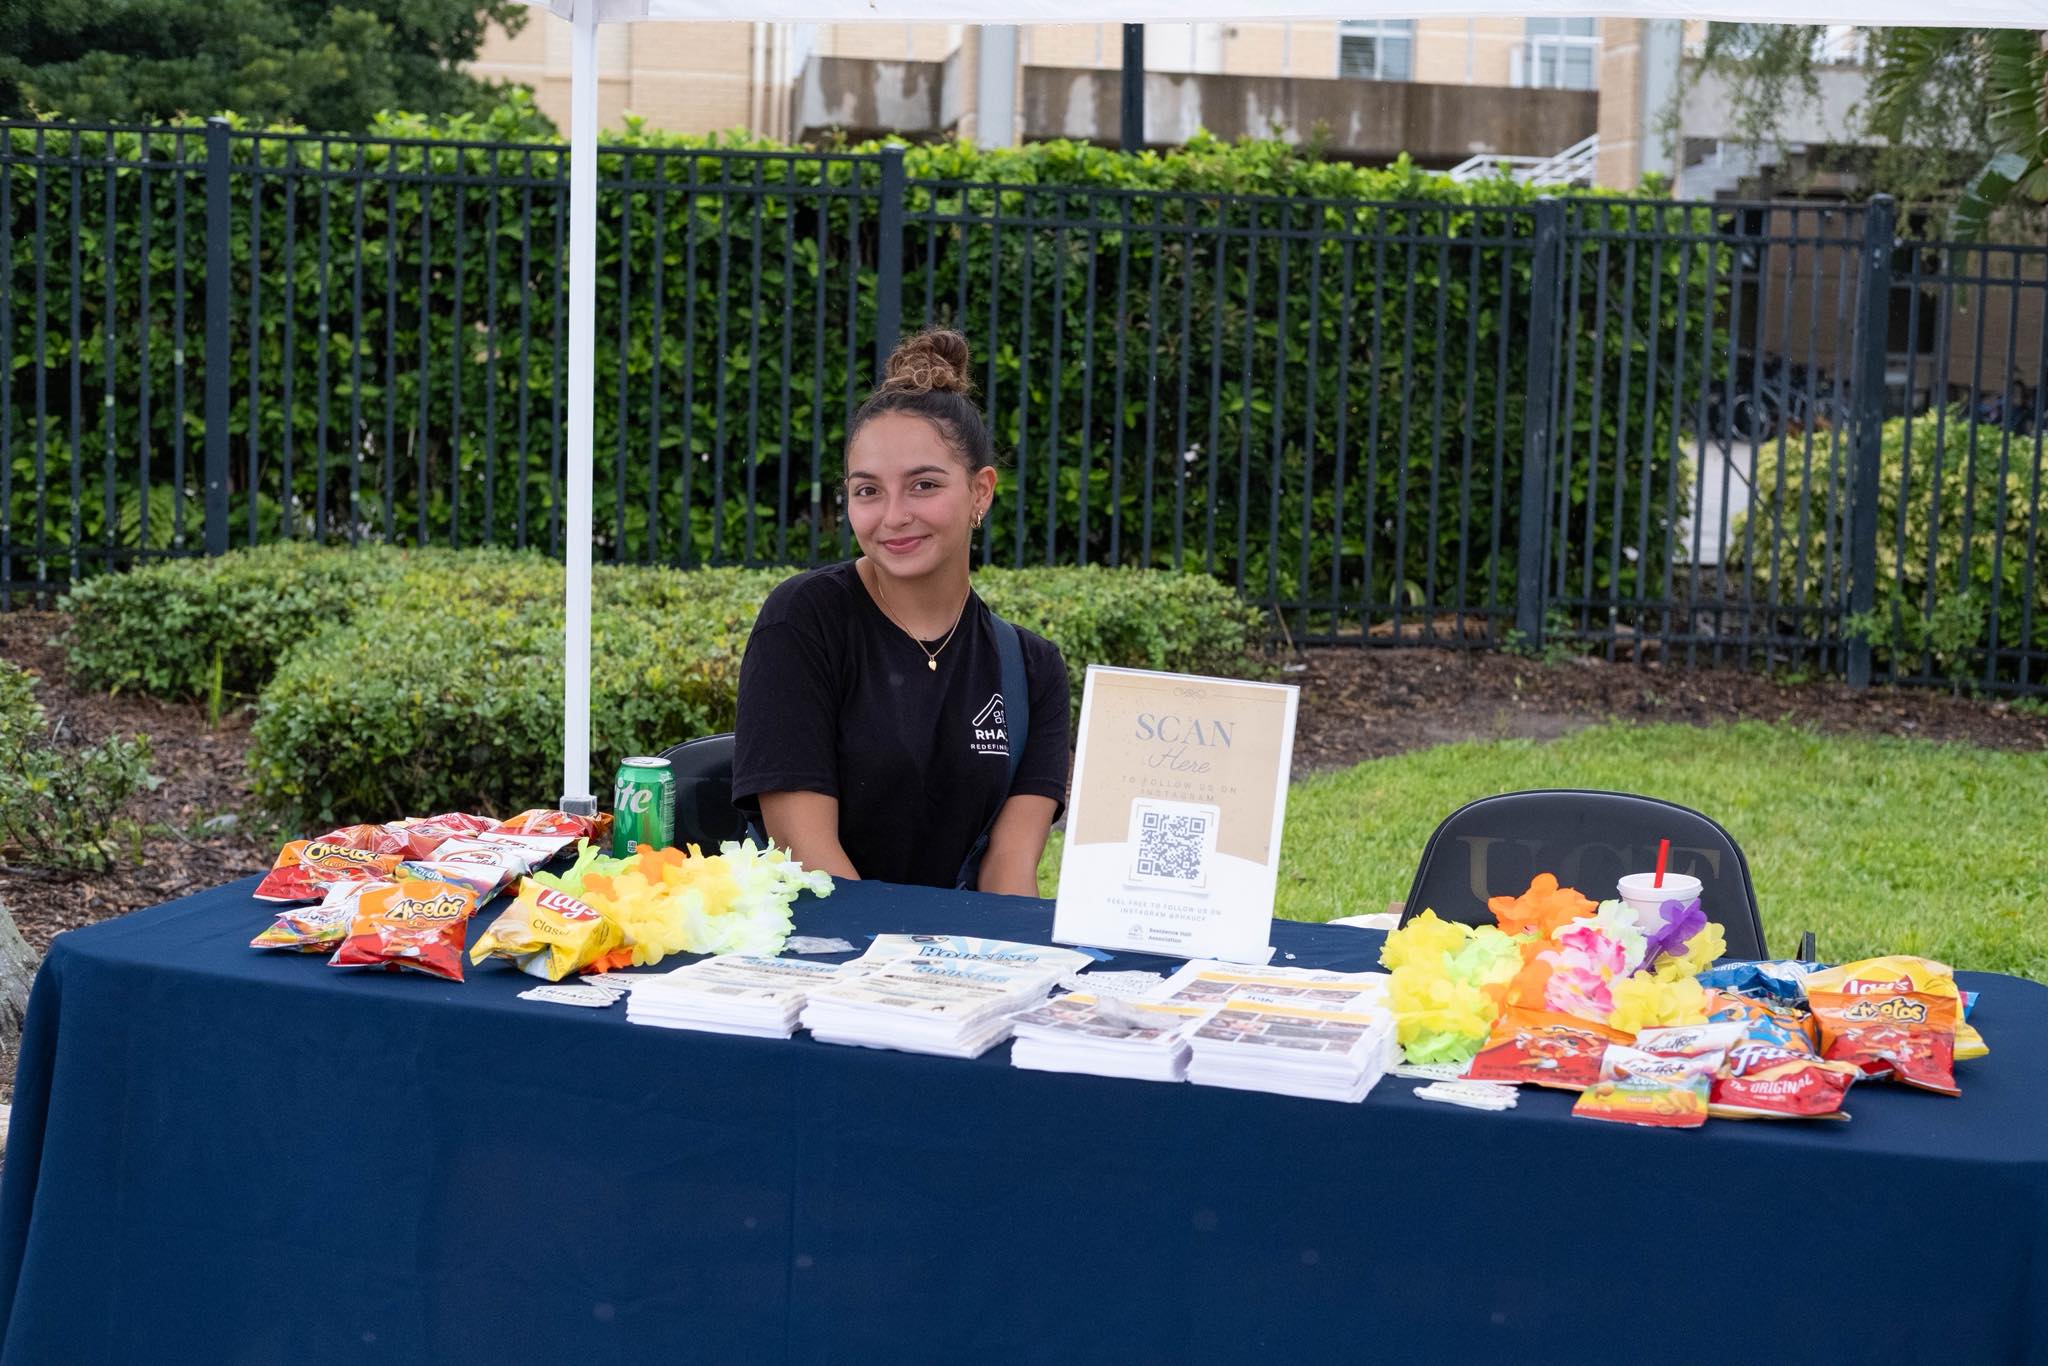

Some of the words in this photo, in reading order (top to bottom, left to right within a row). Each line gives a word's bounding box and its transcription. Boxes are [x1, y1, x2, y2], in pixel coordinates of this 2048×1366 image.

[974, 728, 1006, 740] RHA
[1135, 713, 1236, 748] SCAN
[1148, 746, 1211, 773] Here
[614, 776, 653, 813] ite
[1121, 775, 1136, 783] TO
[1142, 777, 1192, 790] FOLLOW
[1199, 783, 1214, 792] US
[1220, 785, 1237, 795] ON
[304, 842, 378, 862] Cheetos
[1750, 1073, 1814, 1095] ORIGINAL
